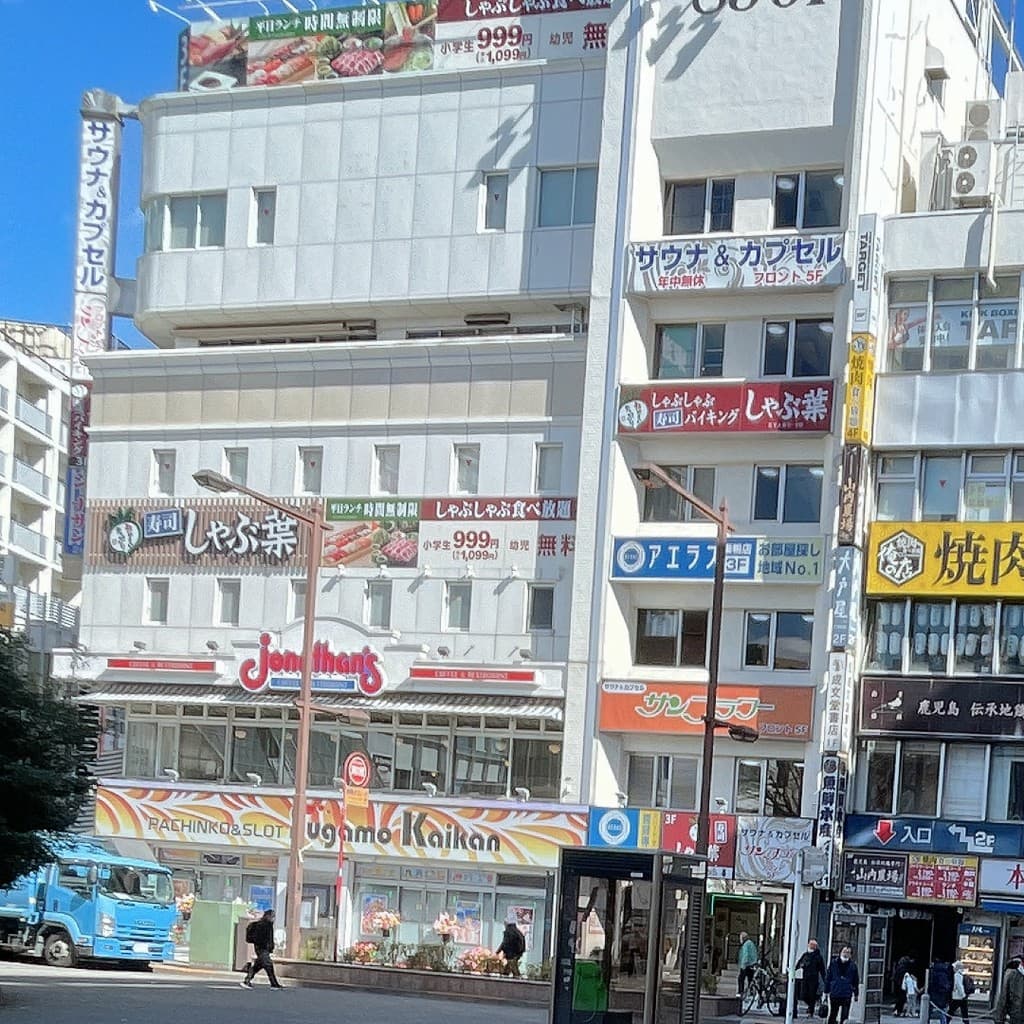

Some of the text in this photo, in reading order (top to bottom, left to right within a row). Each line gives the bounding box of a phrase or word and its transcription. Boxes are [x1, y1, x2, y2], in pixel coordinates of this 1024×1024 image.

[304, 8, 382, 31] 時間無制限
[441, 25, 533, 55] 小学生 999円
[549, 31, 574, 46] 幼児
[856, 234, 868, 292] TARGET
[657, 269, 824, 289] 年中無休 フロント 5F
[651, 391, 716, 409] しゃぶしゃぶ
[745, 387, 829, 423] しゃぶ葉
[684, 408, 741, 426] バイキング
[364, 502, 419, 517] 時間無制限
[435, 500, 572, 520] しゃぶしゃぶ食べ放題
[184, 507, 298, 559] しゃぶ葉
[422, 540, 450, 550] 小学生
[453, 530, 500, 550] 999円
[509, 540, 530, 551] 幼児
[758, 542, 821, 557] お部屋探し
[725, 557, 748, 572] 3F
[757, 560, 820, 575] 地域No.1
[832, 633, 846, 645] 2F
[239, 632, 384, 694] Jonthan's
[917, 698, 960, 717] 鹿児島
[664, 814, 677, 825] 3F
[306, 811, 501, 852] ugamo Kaikan
[900, 825, 932, 845] 入口
[974, 831, 996, 846] 2F
